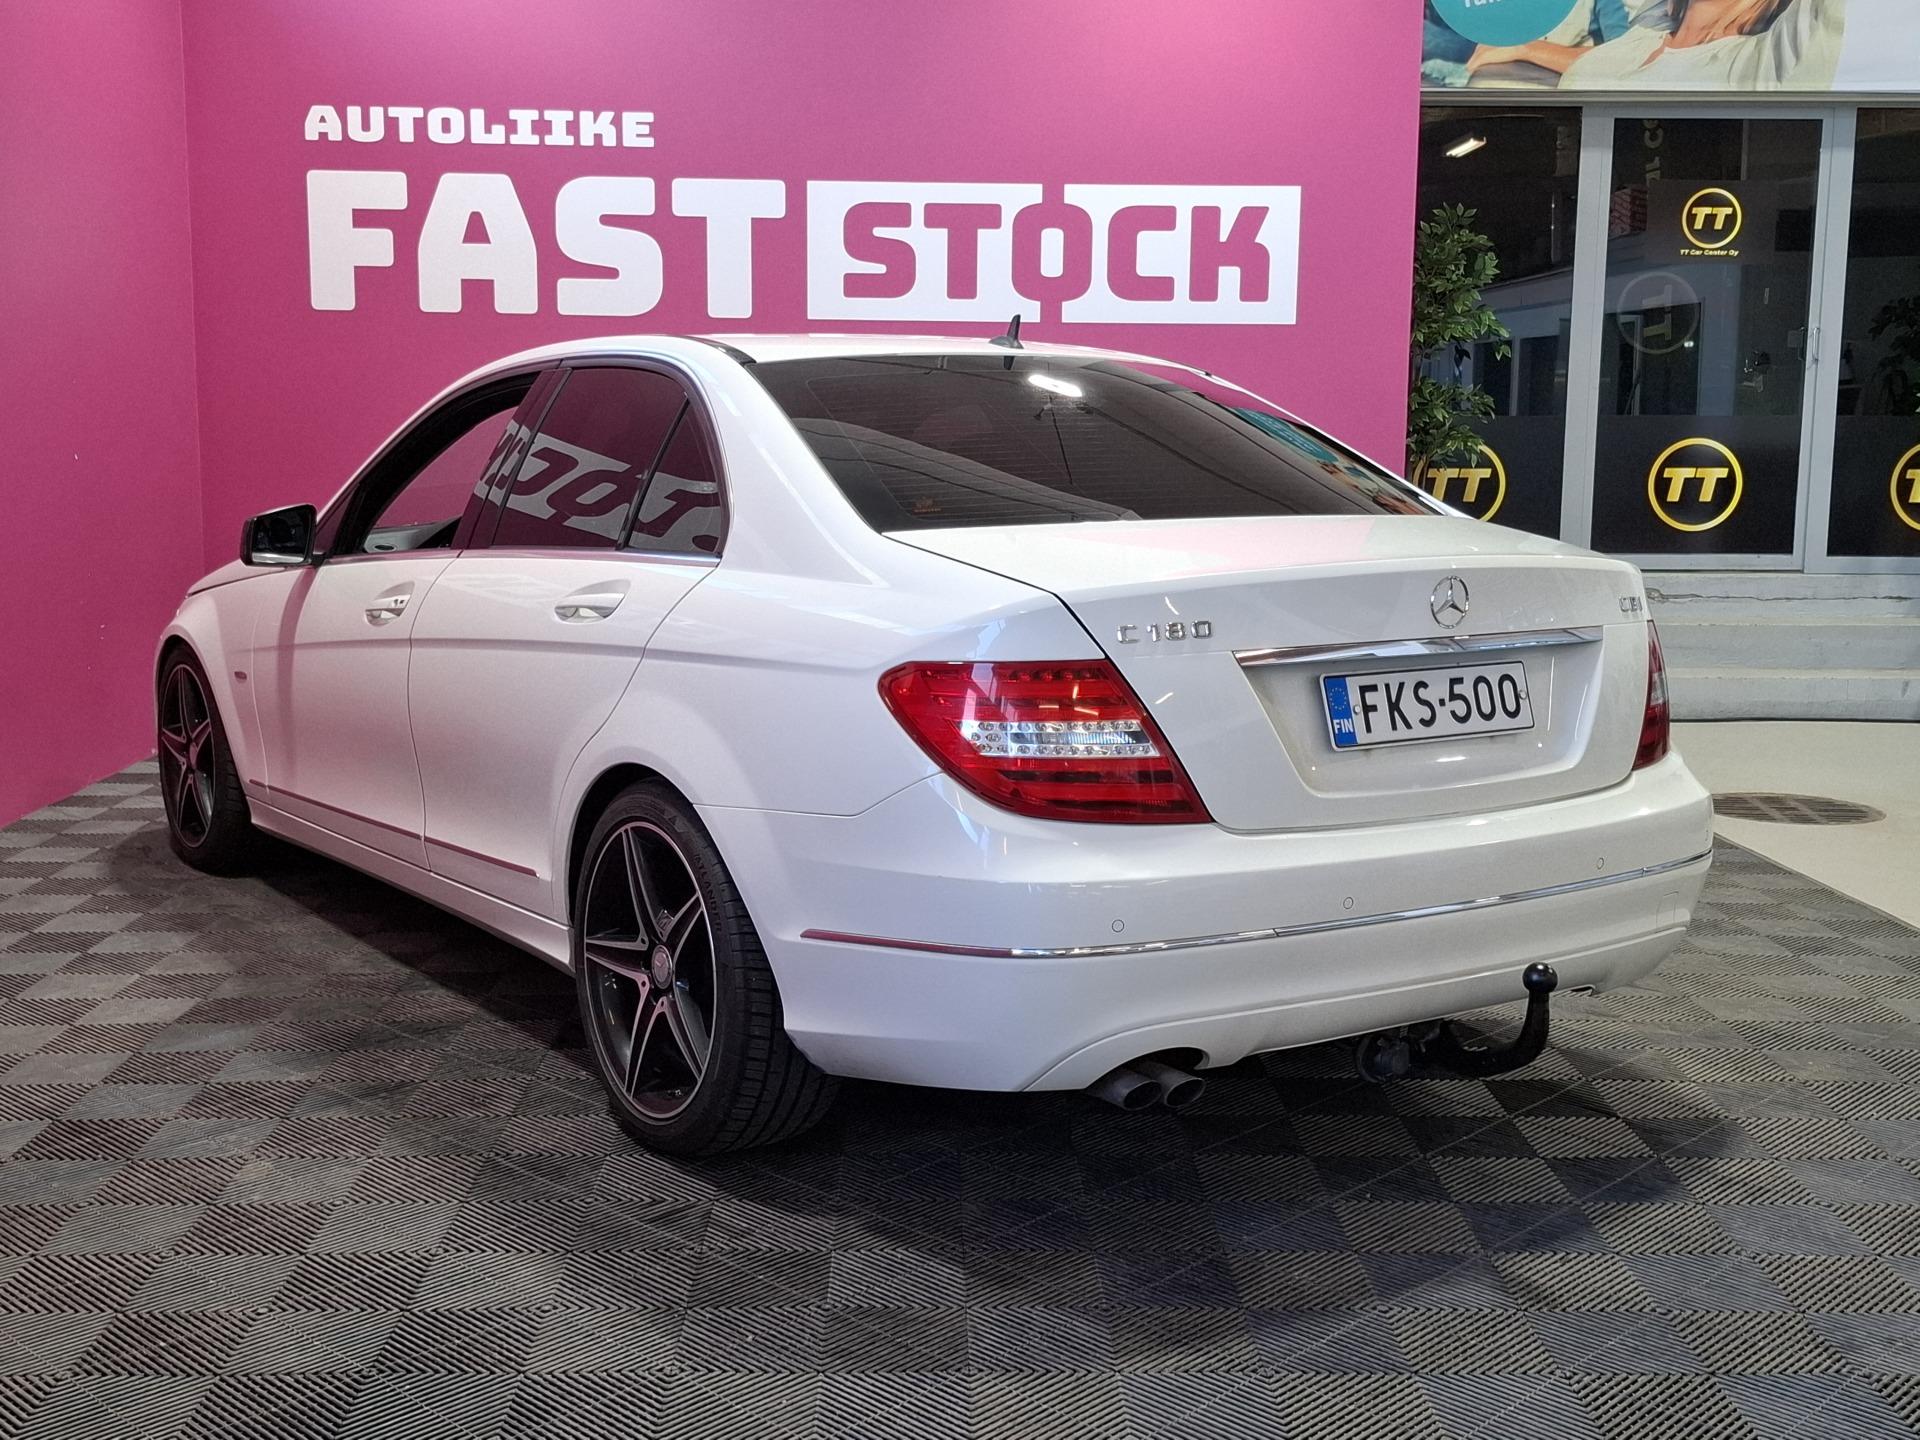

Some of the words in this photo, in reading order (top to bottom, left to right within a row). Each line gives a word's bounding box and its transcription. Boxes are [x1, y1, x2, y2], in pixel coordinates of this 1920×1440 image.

[304, 104, 655, 148] AUTOLIIKE
[1692, 206, 1733, 230] TT
[306, 169, 786, 319] FAST
[842, 201, 1271, 302] STOCK
[1427, 468, 1492, 503] TT
[1663, 467, 1729, 502] TT
[1905, 469, 1920, 503] T
[1117, 624, 1139, 644] C
[1146, 620, 1212, 642] 180
[1358, 673, 1521, 734] FKS-500
[1332, 718, 1354, 734] FIN
